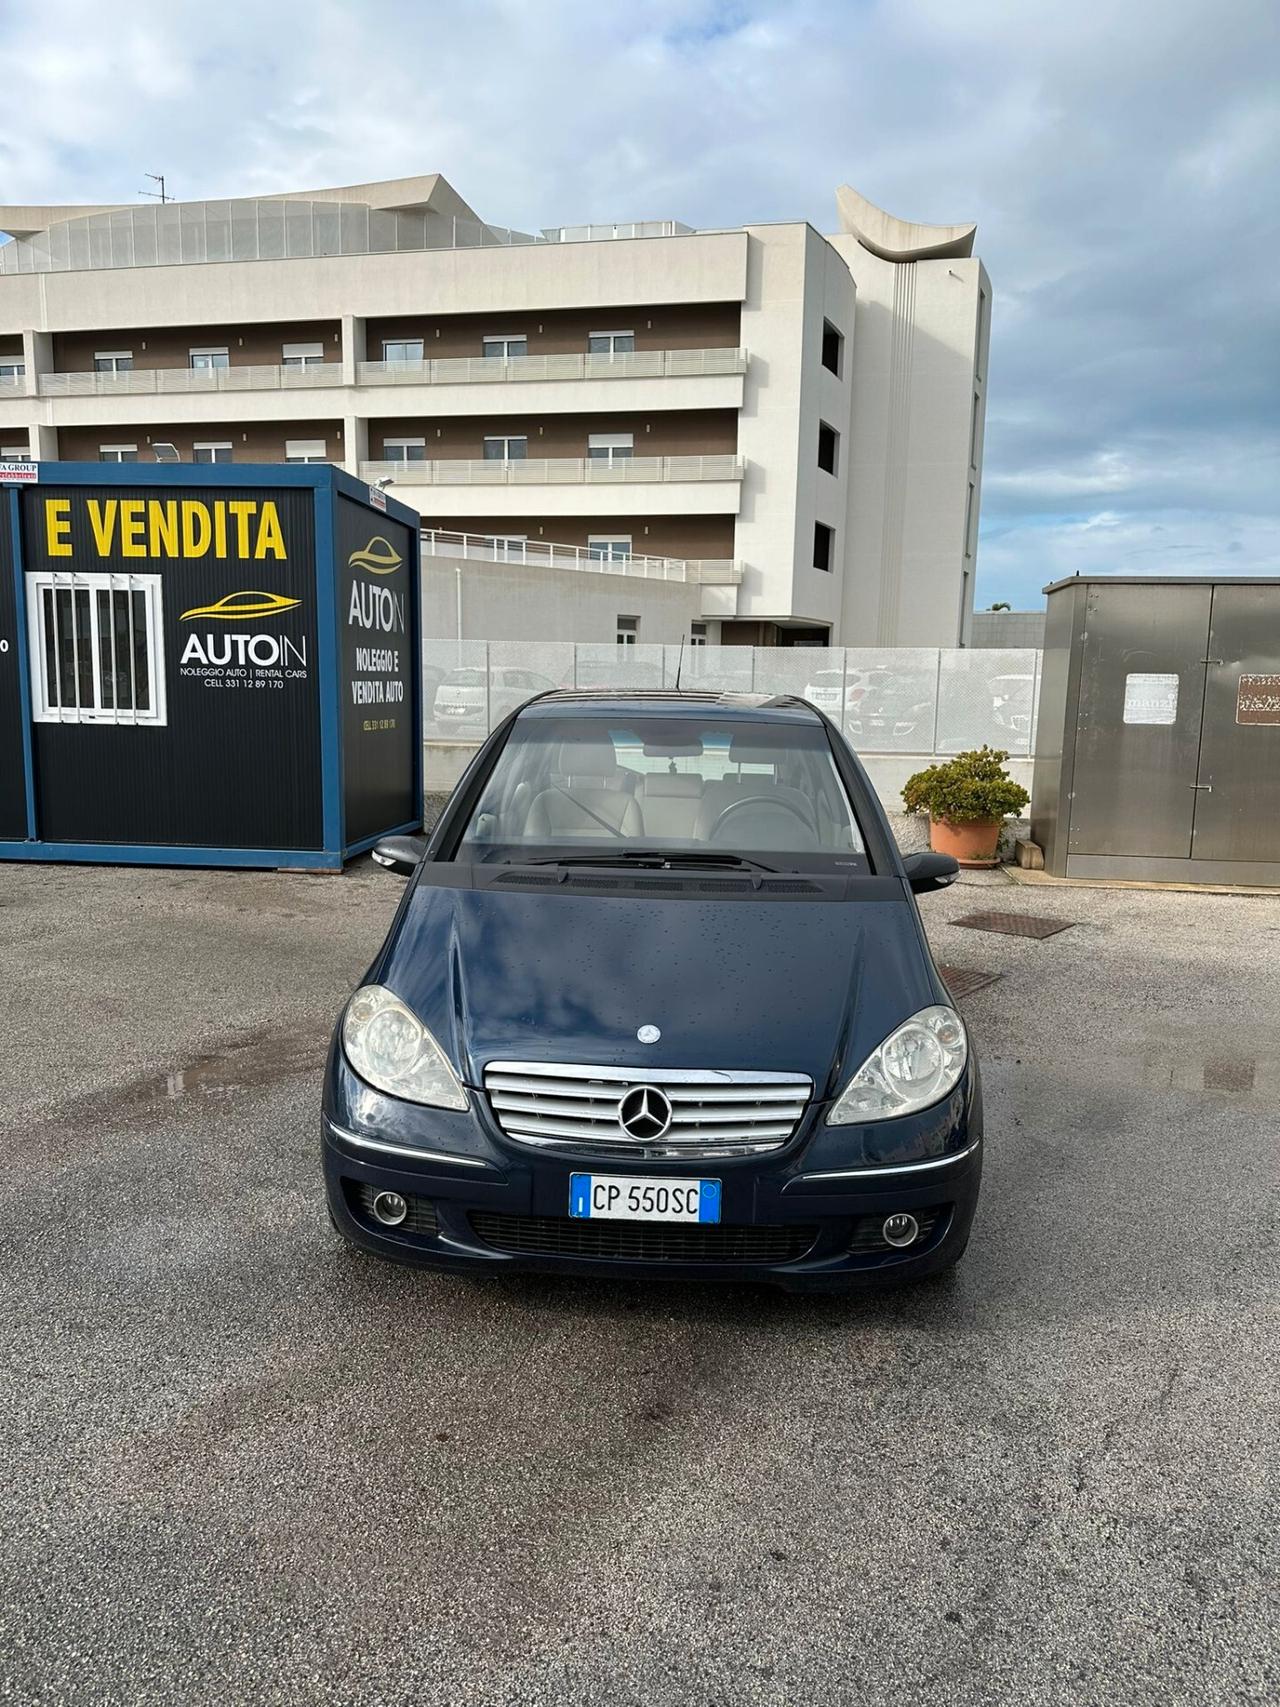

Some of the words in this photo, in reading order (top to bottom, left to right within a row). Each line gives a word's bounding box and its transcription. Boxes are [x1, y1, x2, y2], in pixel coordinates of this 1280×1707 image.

[8, 464, 36, 472] GROUP
[45, 499, 73, 557] E
[87, 499, 287, 560] VENDITA
[180, 633, 307, 667] AUTOIN
[356, 647, 393, 672] NOLEGGIO
[393, 650, 399, 672] E
[180, 667, 225, 677] NOLEGGIO
[225, 668, 247, 677] AUTO
[255, 669, 284, 678] RENTAL
[285, 670, 307, 679] CARS
[204, 679, 224, 688] CELL
[225, 679, 240, 688] 331
[243, 680, 253, 688] 12
[255, 680, 266, 688] 89
[269, 680, 284, 689] 170
[351, 680, 384, 705] VENDITA
[385, 680, 404, 703] AUTO
[593, 1184, 621, 1211] CP
[627, 1185, 699, 1215] 550SC
